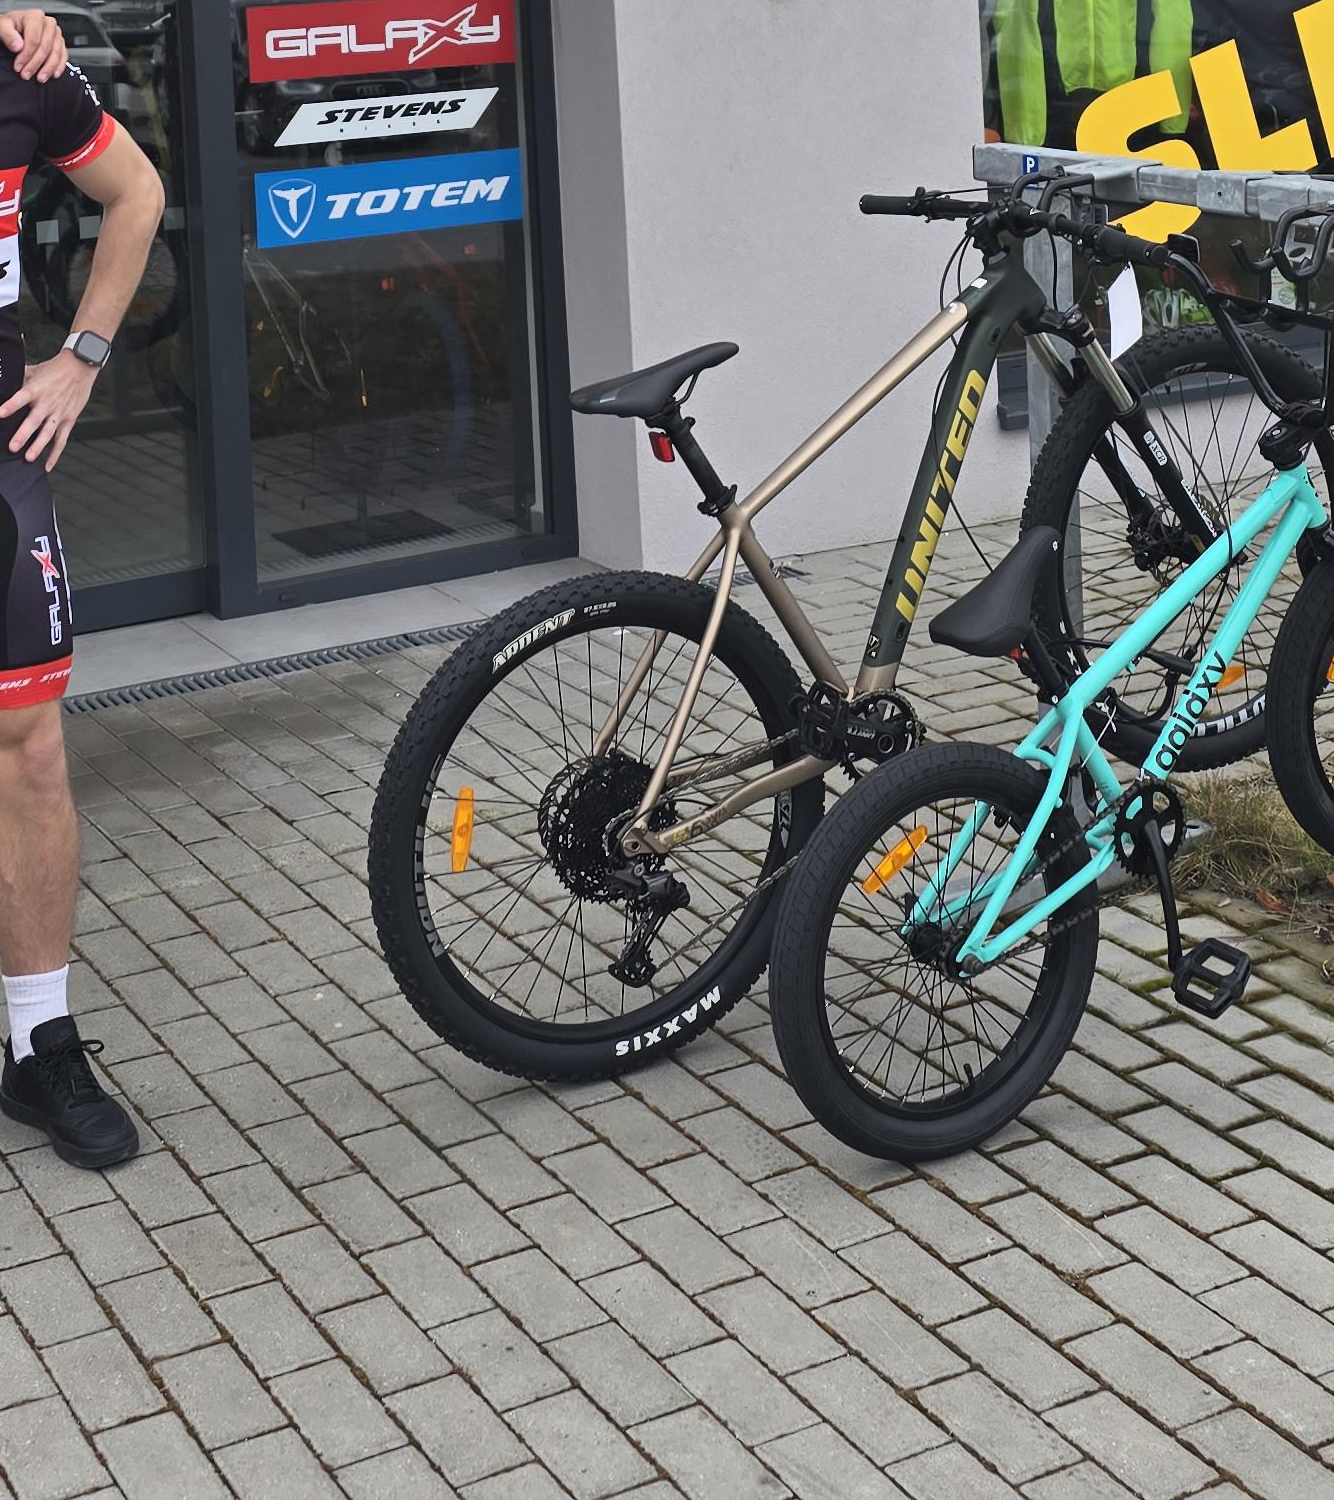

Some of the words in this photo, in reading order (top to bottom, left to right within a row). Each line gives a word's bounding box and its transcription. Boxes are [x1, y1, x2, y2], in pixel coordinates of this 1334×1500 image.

[265, 2, 500, 64] GALAXY
[316, 97, 467, 126] STEVENS
[325, 174, 511, 220] TOTEM
[894, 369, 987, 624] UNITED
[30, 535, 64, 646] GALAXY
[615, 985, 723, 1058] MAXXIS
